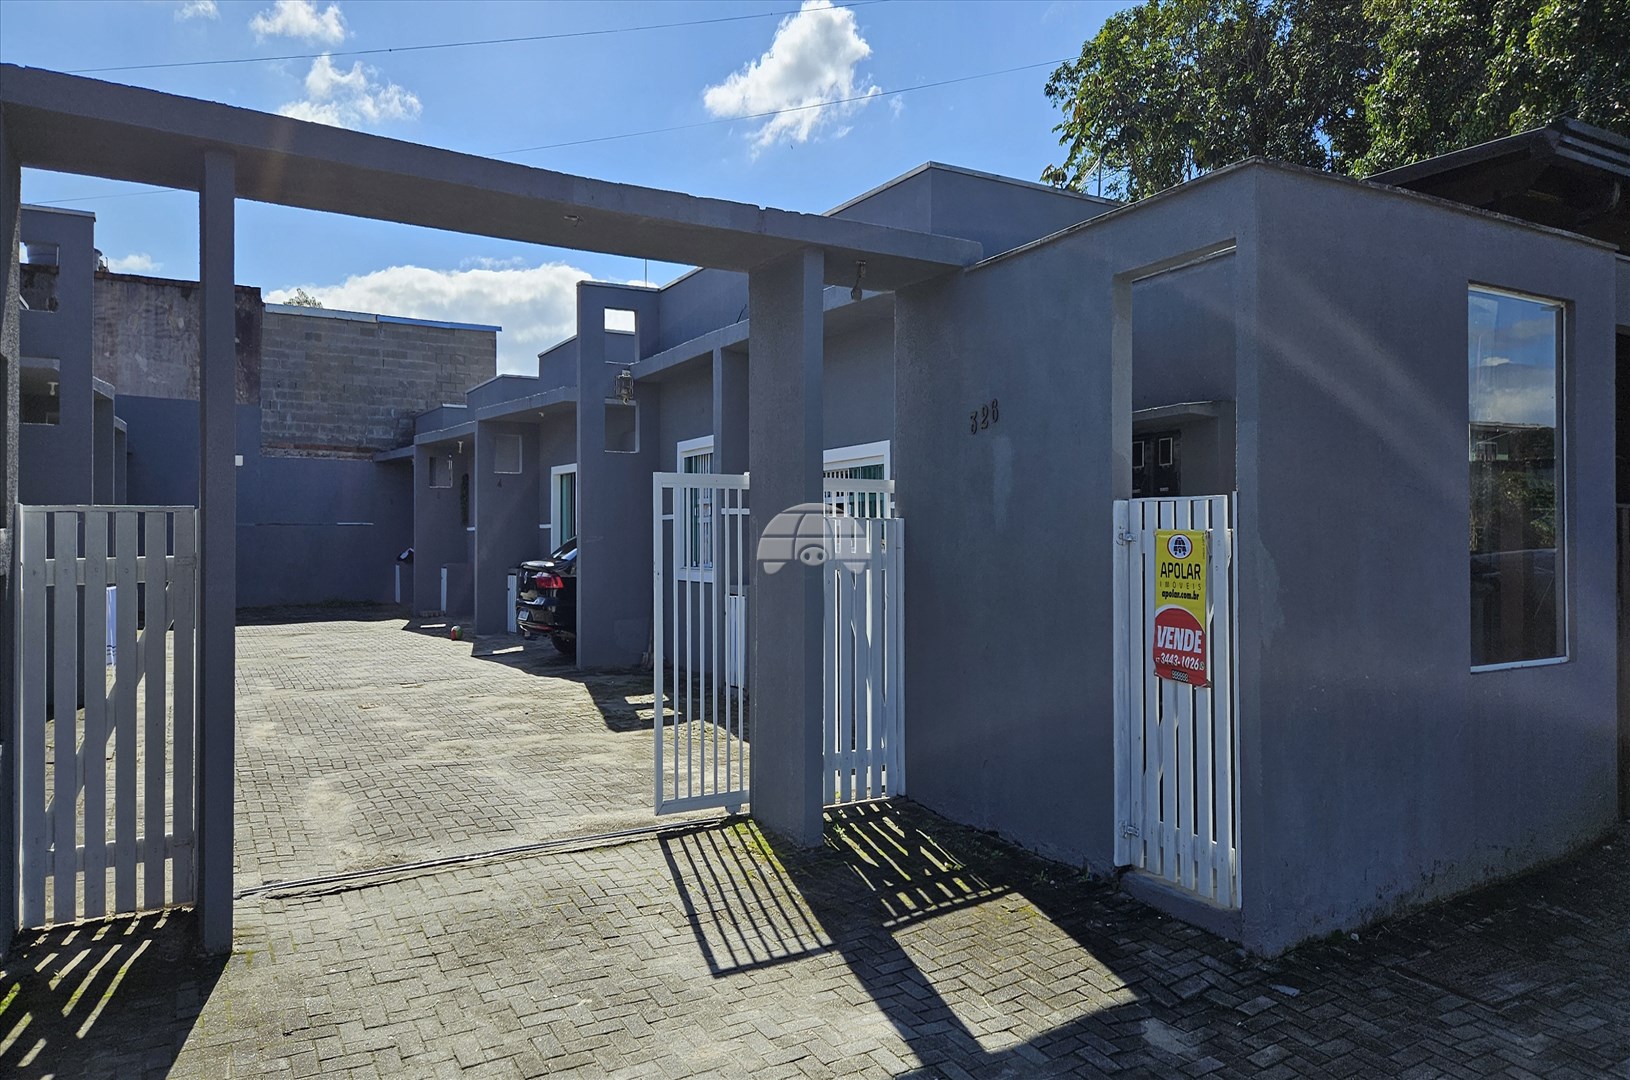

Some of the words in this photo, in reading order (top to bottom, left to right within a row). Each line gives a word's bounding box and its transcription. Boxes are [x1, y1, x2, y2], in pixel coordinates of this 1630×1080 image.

[1160, 561, 1201, 580] APOLAR
[1161, 588, 1200, 600] apolar.com.br
[1157, 625, 1203, 654] VENDE
[1160, 652, 1199, 671] 3443-1026
